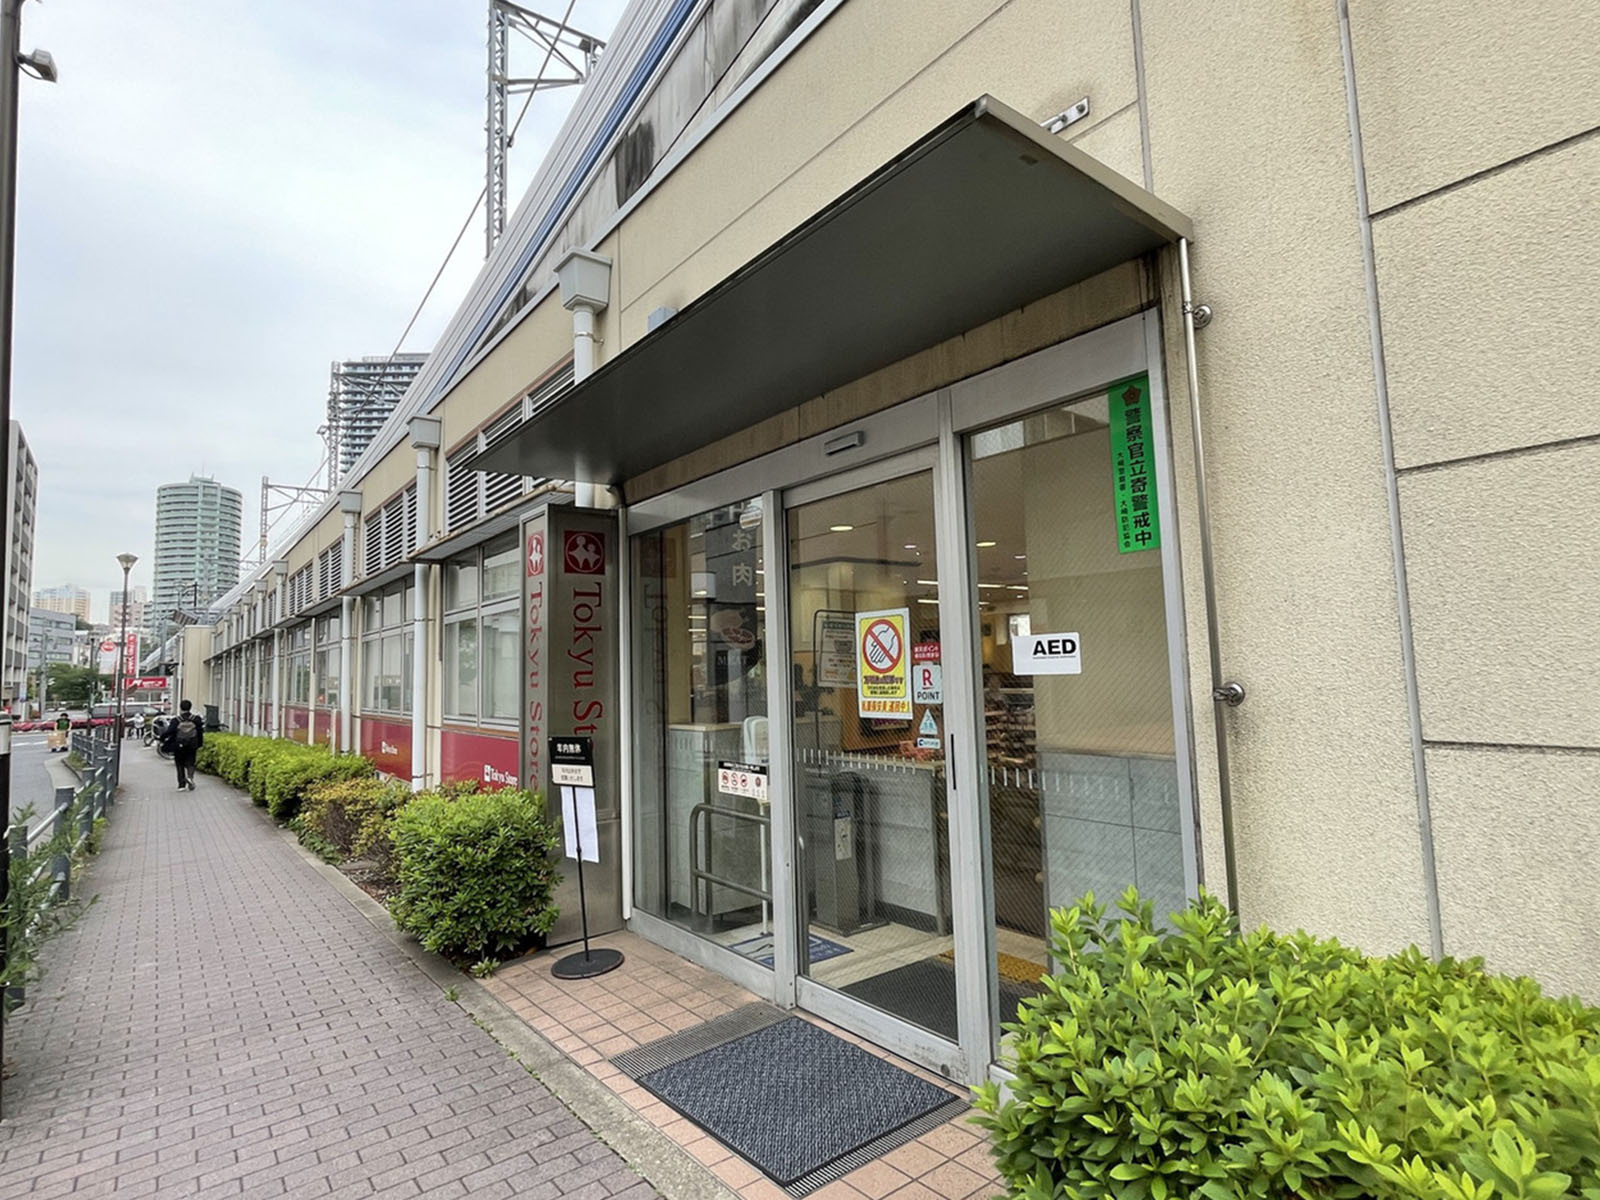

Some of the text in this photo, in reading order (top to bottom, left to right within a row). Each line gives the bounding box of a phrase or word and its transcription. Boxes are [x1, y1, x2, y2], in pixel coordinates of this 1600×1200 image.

[1125, 408, 1152, 546] 警察官立寄警戒中
[732, 530, 752, 587] お肉
[567, 581, 603, 689] Tokyu
[1032, 638, 1077, 656] AED
[527, 581, 543, 792] Tokyu Store
[917, 691, 940, 701] POINT
